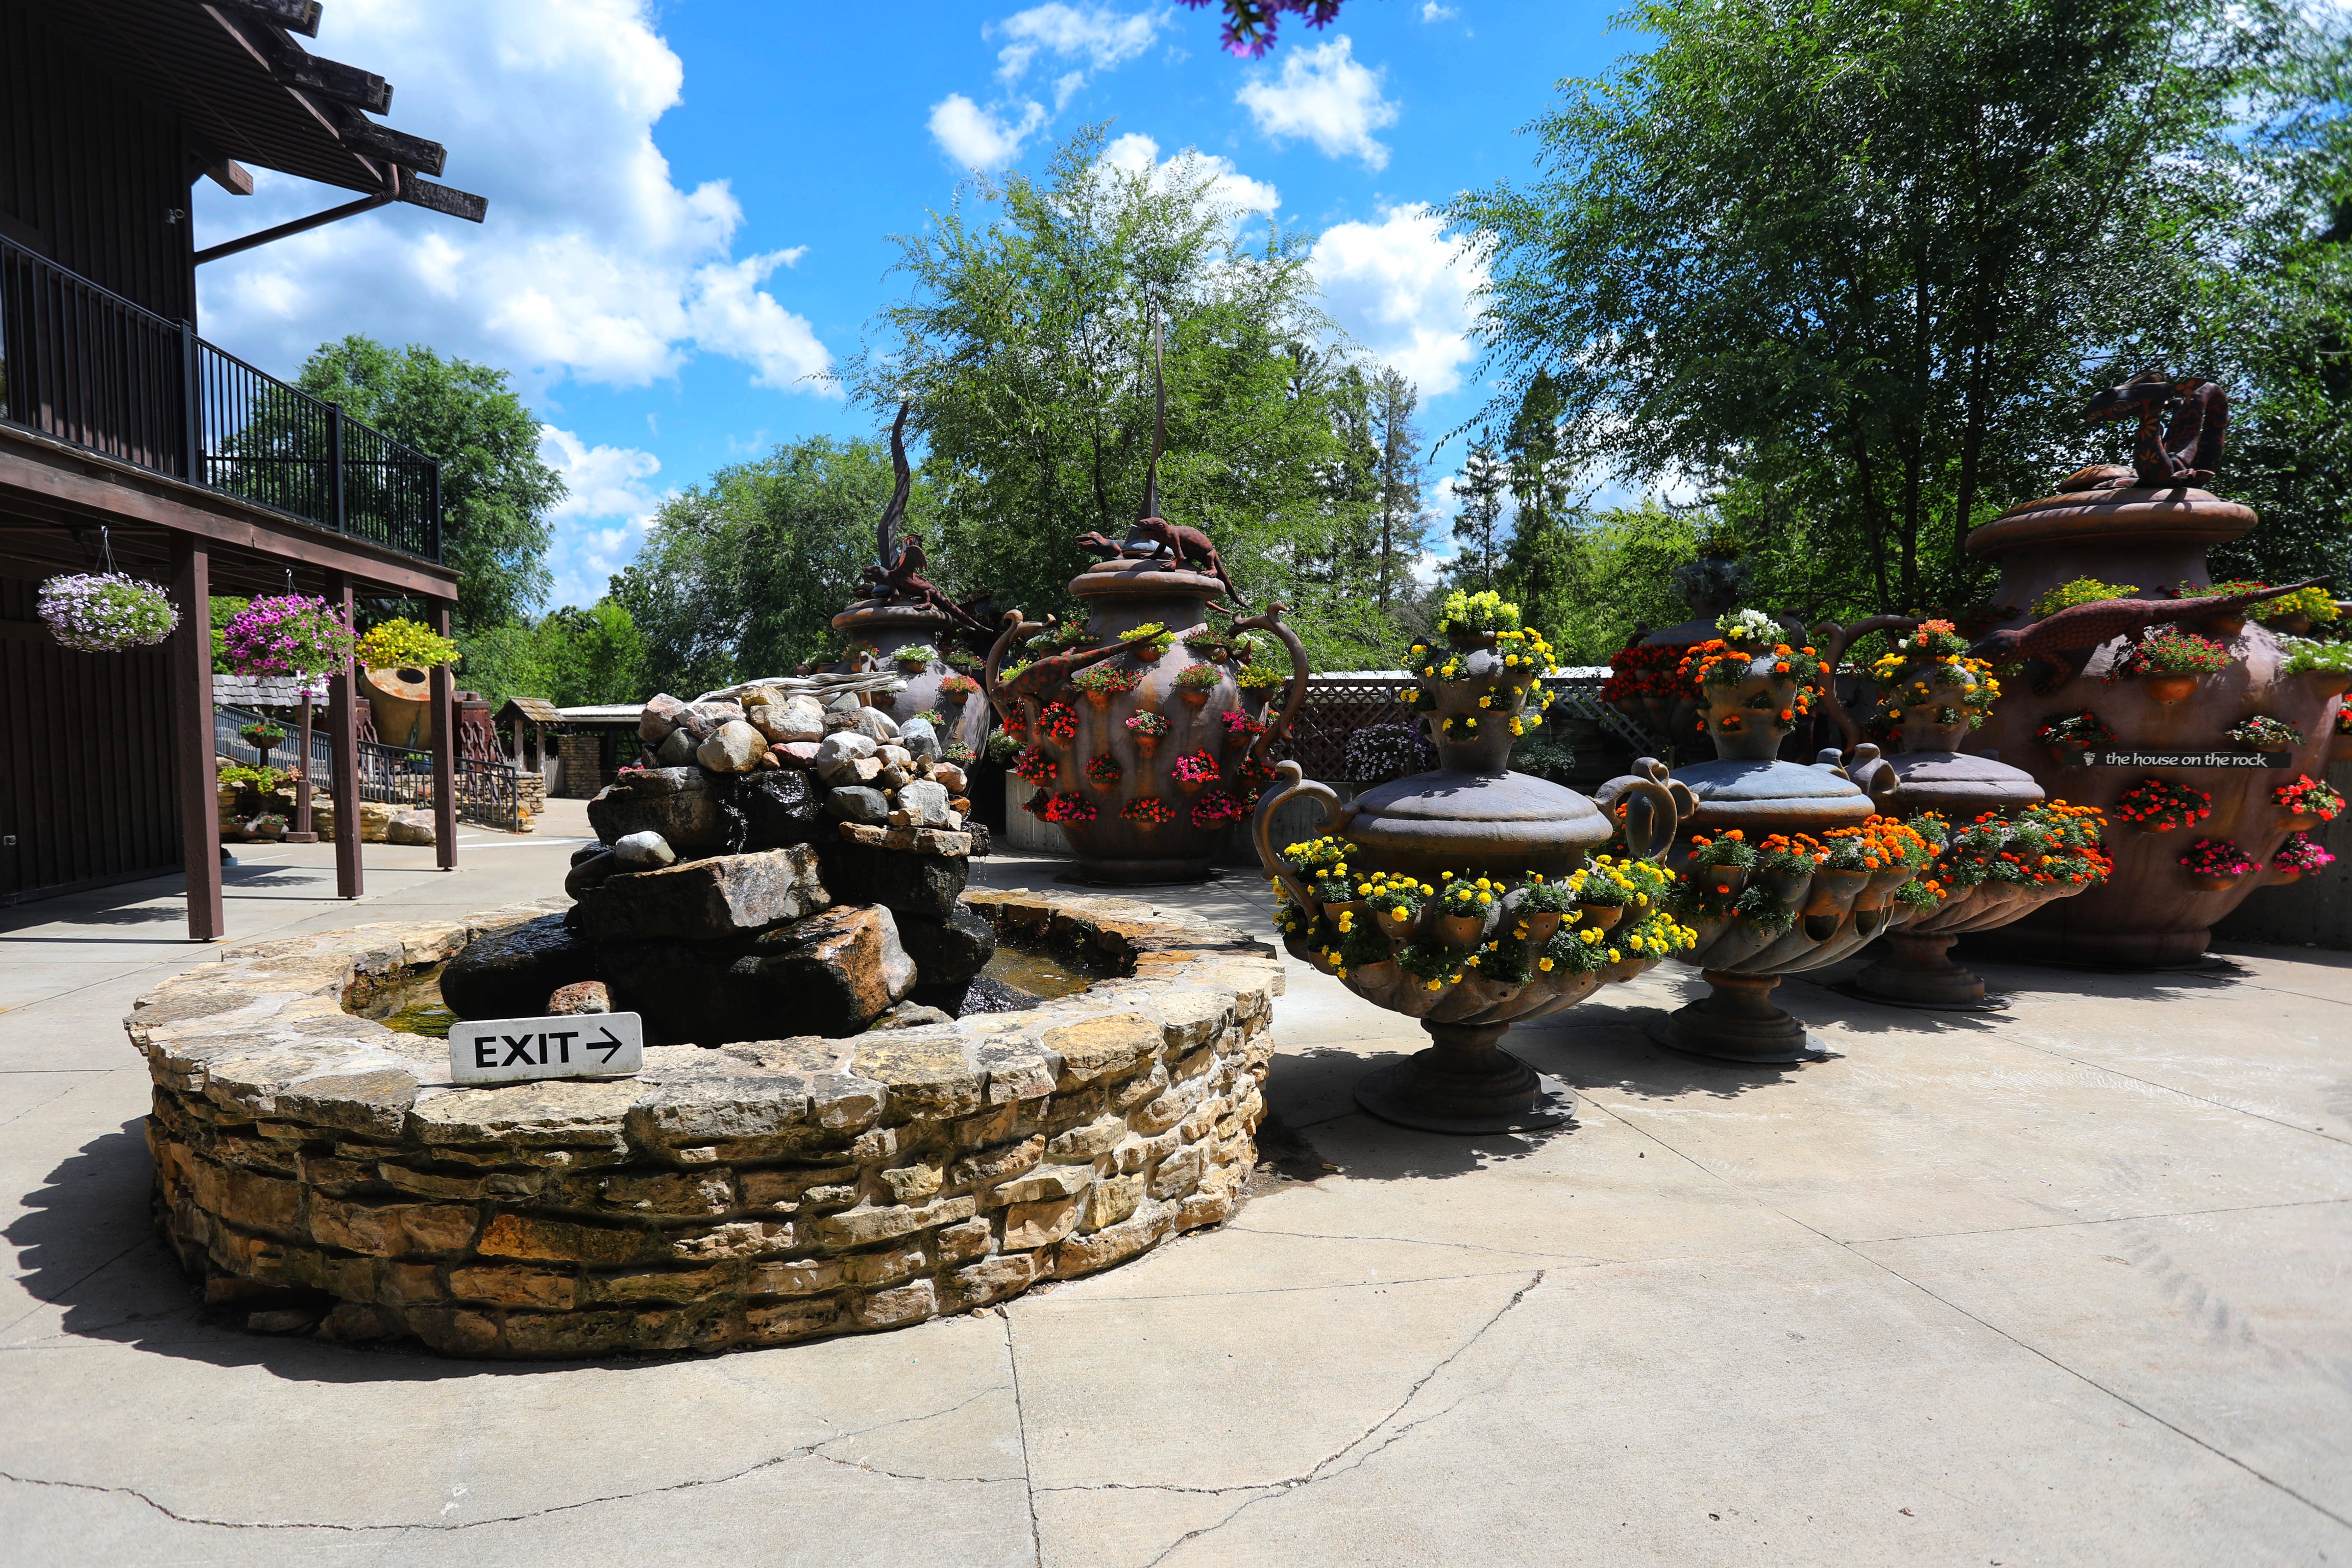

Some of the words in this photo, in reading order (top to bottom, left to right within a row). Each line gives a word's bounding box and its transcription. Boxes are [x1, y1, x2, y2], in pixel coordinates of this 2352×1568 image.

[2105, 752, 2130, 766] the
[2133, 752, 2178, 767] house
[2181, 756, 2200, 766] on
[2204, 753, 2229, 767] the
[2233, 753, 2268, 768] rock
[475, 1031, 579, 1068] EXIT
